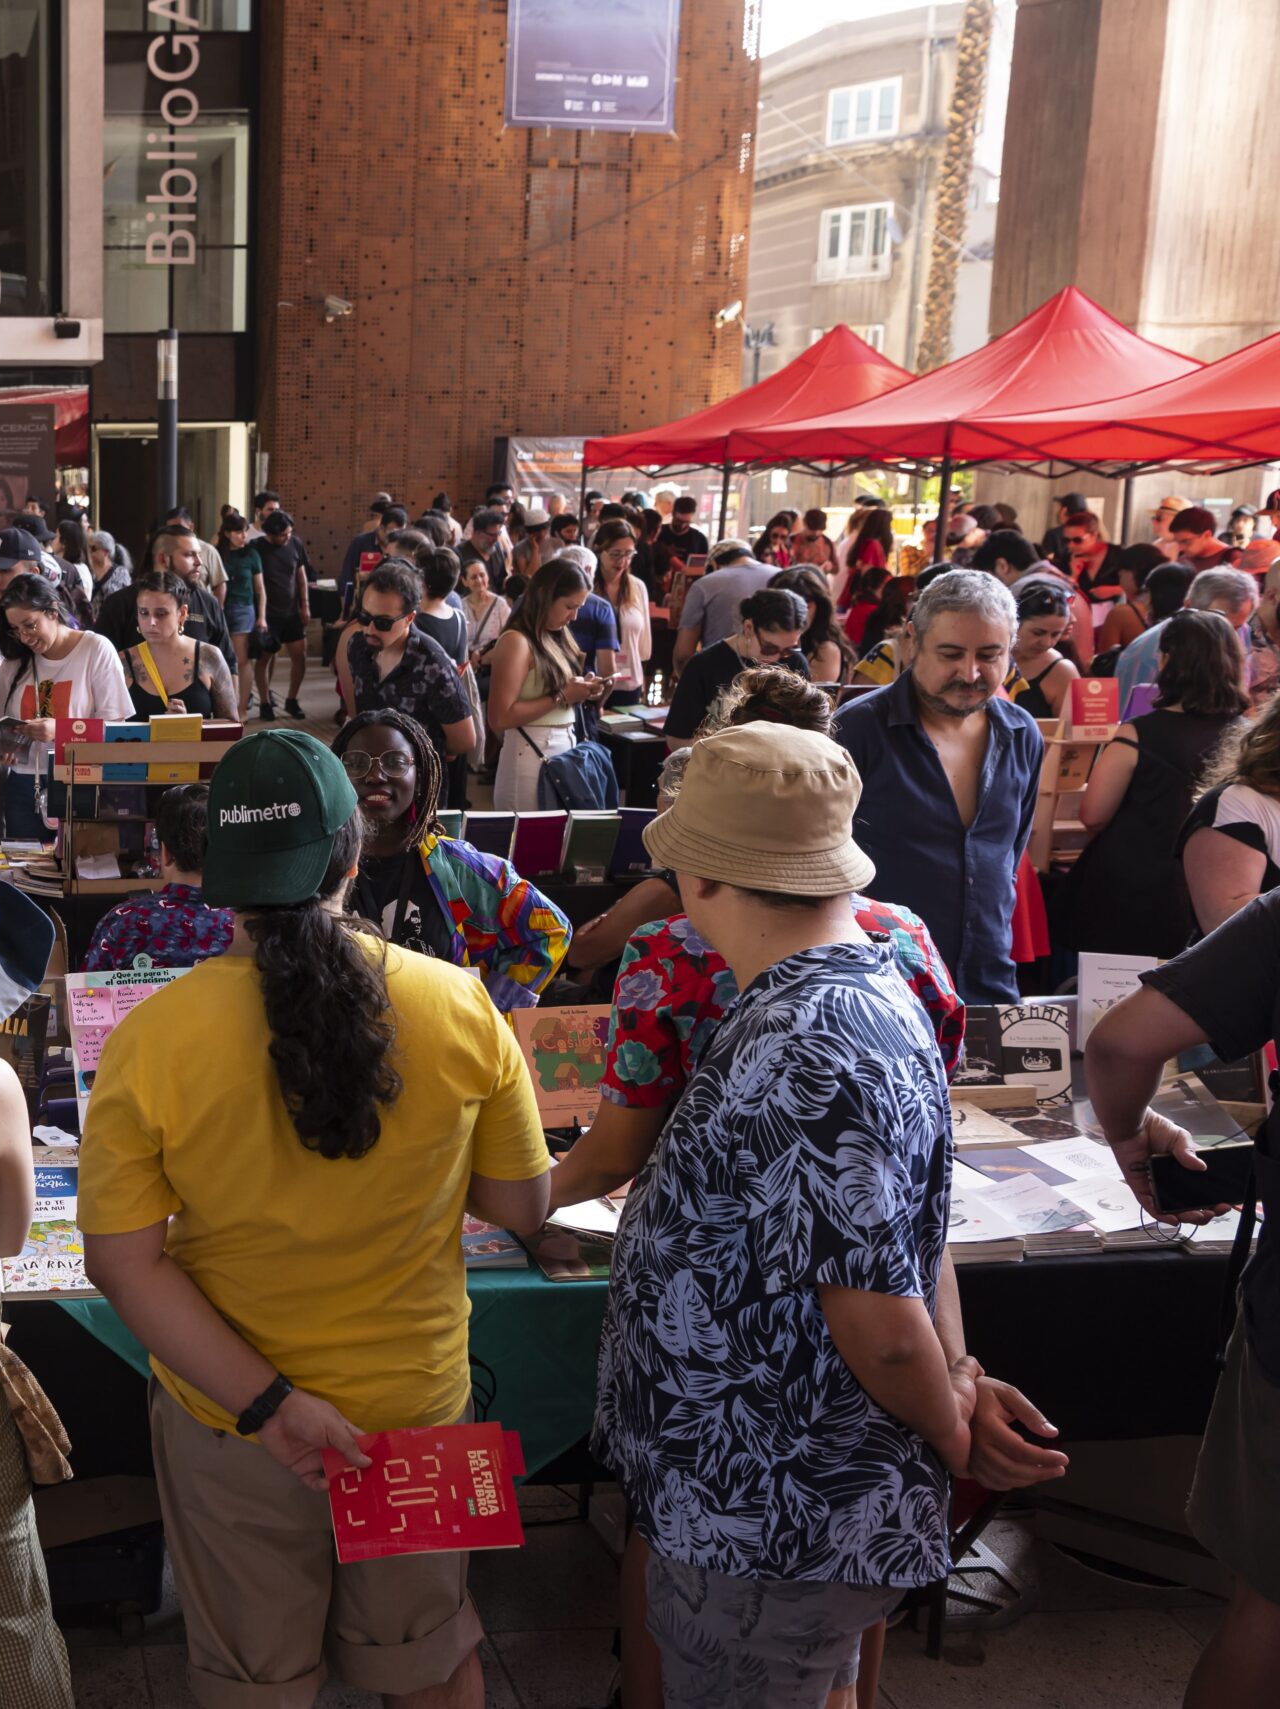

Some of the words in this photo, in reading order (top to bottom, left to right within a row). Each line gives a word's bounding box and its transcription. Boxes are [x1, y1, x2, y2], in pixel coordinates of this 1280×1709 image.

[117, 976, 177, 985] antirracismo?
[143, 971, 161, 979] para
[466, 1450, 480, 1475] DEL
[476, 1449, 489, 1468] LA
[472, 1476, 489, 1516] LIBRO
[480, 1470, 500, 1516] FURIA
